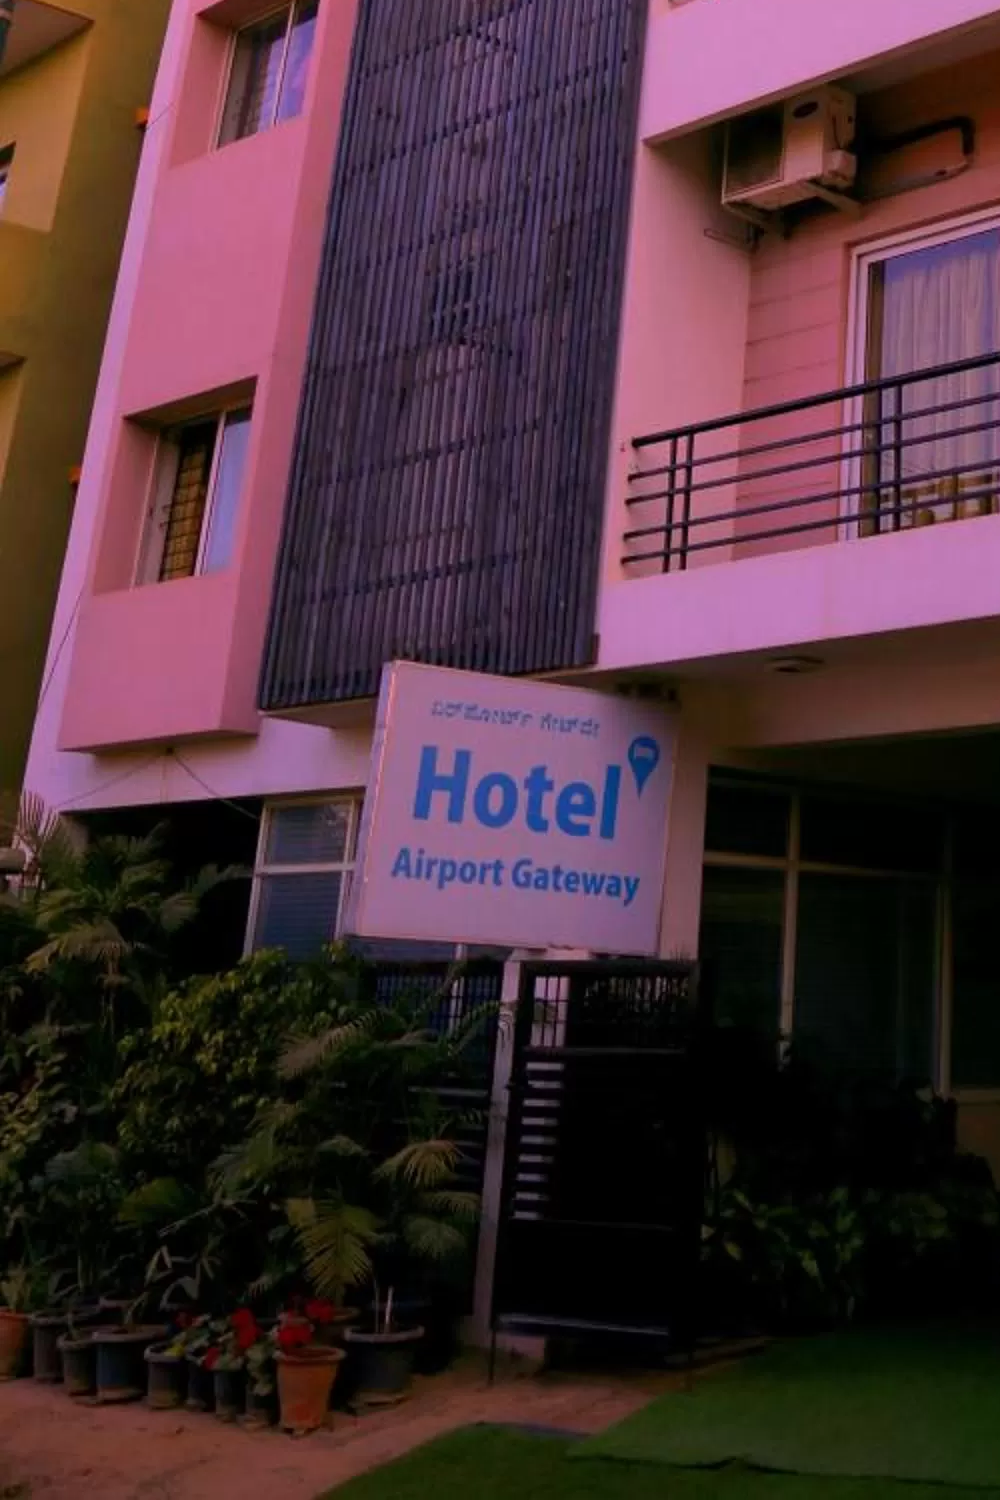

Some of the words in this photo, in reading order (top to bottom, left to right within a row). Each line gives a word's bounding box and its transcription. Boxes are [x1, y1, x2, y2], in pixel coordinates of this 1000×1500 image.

[412, 744, 621, 841] Hotel
[391, 846, 506, 890] Airport
[511, 858, 641, 907] Gateway
